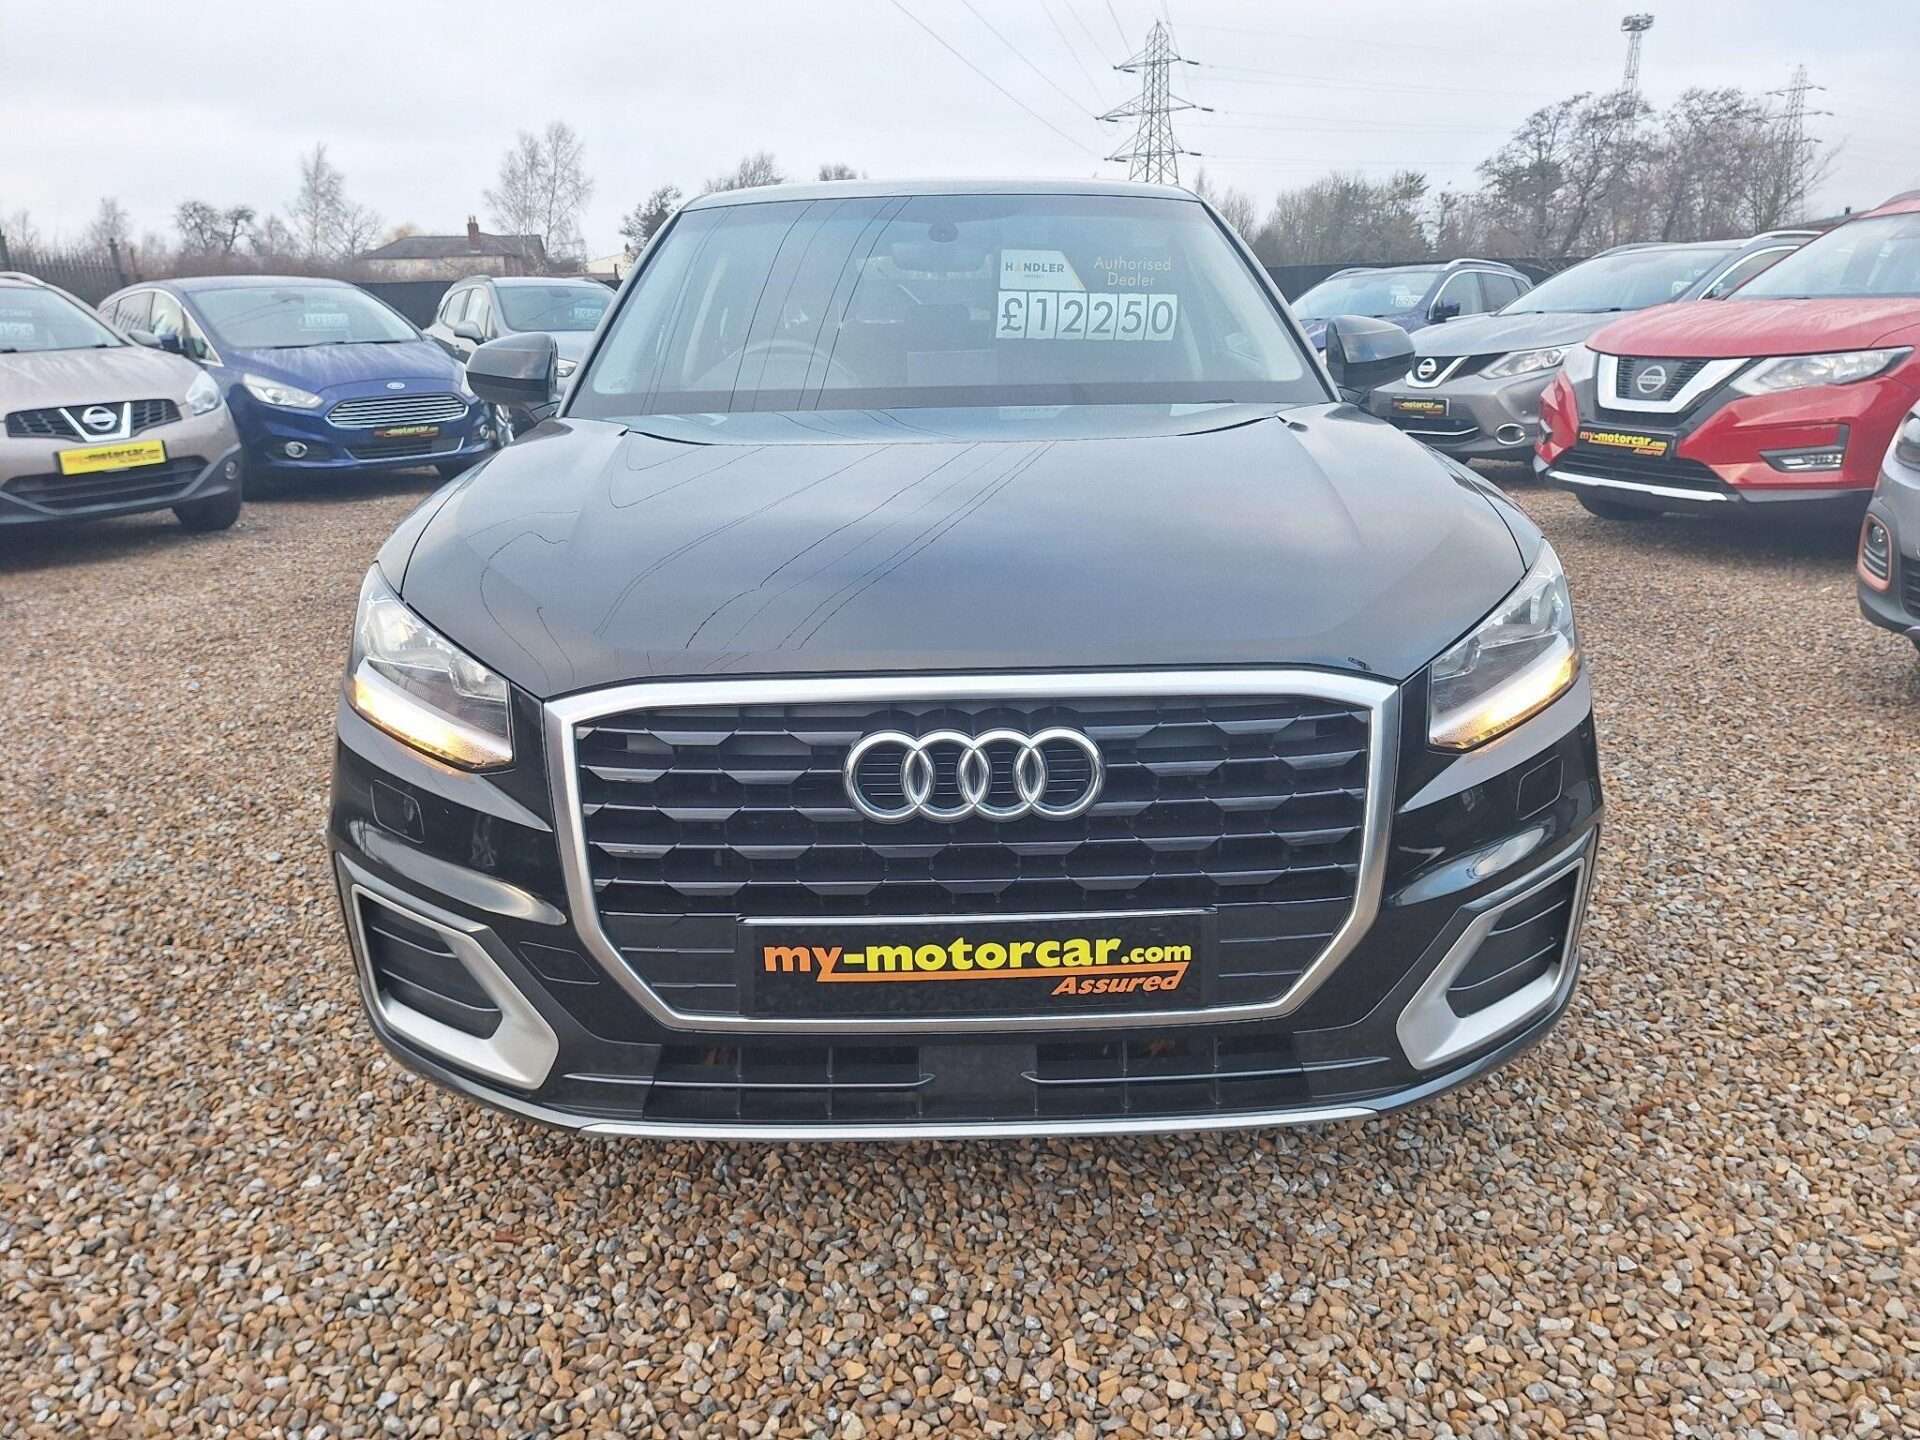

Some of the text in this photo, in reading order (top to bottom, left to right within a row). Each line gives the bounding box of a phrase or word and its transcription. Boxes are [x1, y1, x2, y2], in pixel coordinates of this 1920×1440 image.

[1005, 262, 1065, 273] HNDLER
[1093, 256, 1172, 271] Authorised
[1107, 272, 1156, 286] Dealer
[1001, 297, 1174, 334] £12250
[763, 936, 1192, 982] my-motorcar.com
[1051, 973, 1179, 996] Assured
